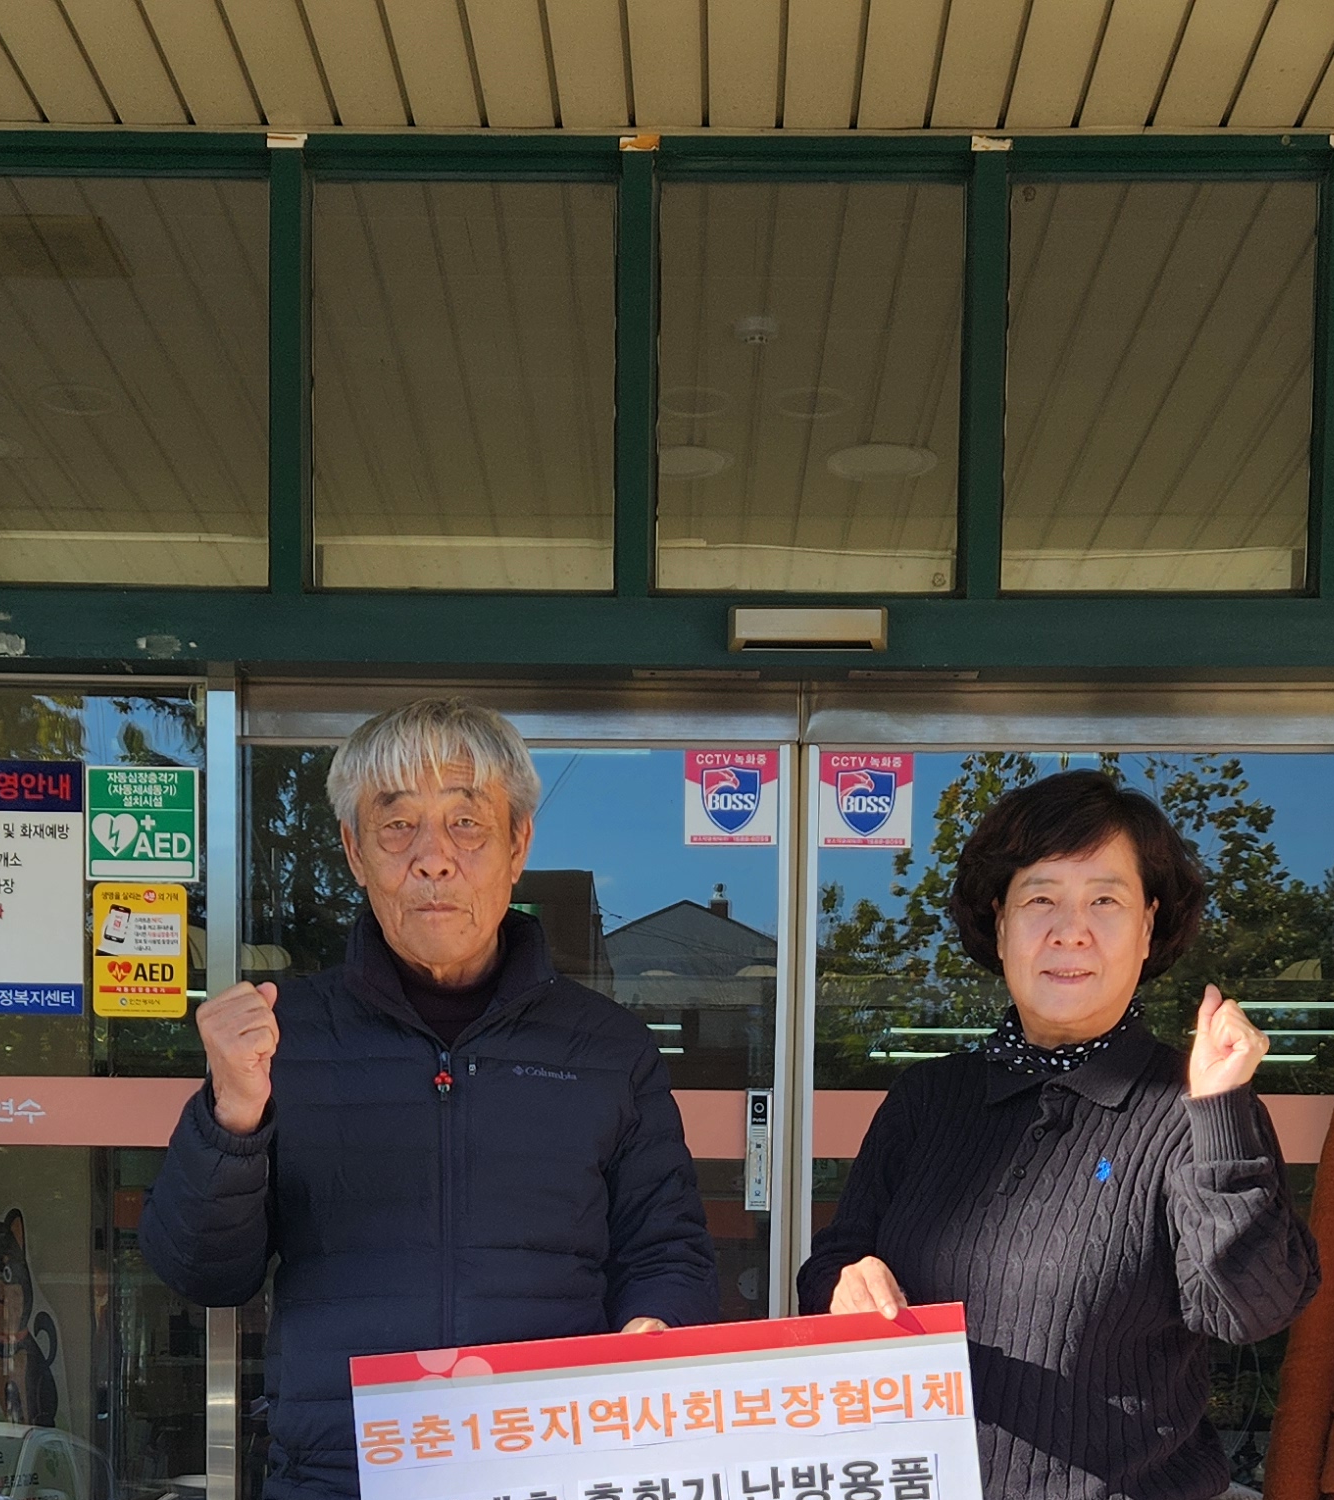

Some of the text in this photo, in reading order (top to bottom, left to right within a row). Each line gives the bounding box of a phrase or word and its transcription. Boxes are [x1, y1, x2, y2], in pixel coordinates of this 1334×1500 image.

[695, 753, 768, 766] CCTV 녹화중
[830, 755, 903, 768] CCTV 녹화중
[107, 771, 179, 785] 자동심장충격기
[122, 795, 164, 808] 설치시설
[707, 793, 756, 812] BOSS
[842, 796, 891, 814] BOSS
[3, 823, 16, 840] 및
[19, 823, 71, 841] 화재예방
[132, 831, 192, 859] AED
[133, 962, 175, 983] AED
[524, 1066, 578, 1081] Columbia
[359, 1370, 967, 1466] 동춘1동지역사회보장협의체
